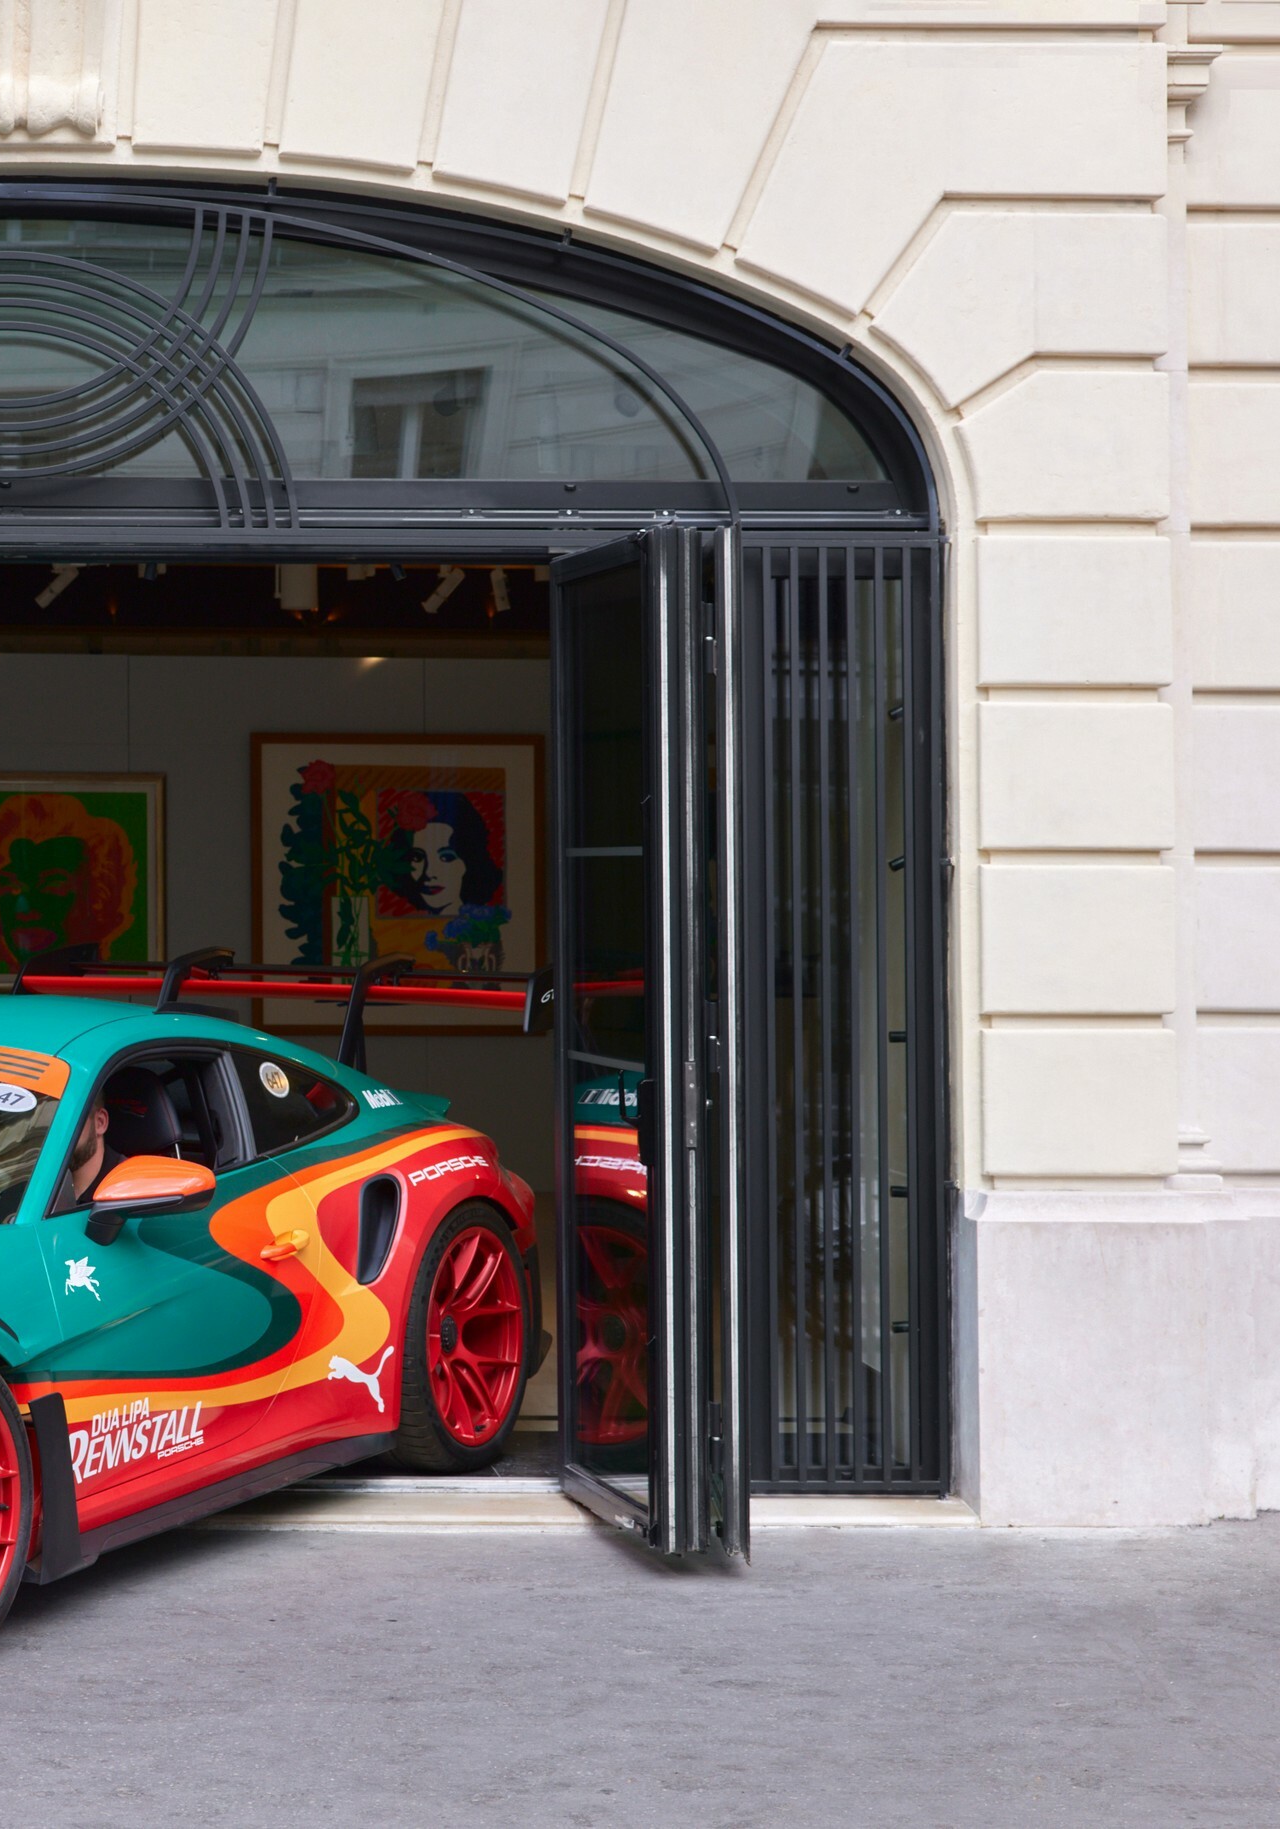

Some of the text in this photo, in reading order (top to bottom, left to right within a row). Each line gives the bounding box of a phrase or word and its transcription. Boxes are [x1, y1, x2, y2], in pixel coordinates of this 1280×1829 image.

[265, 1071, 284, 1089] 647
[361, 1089, 395, 1109] Mobil
[408, 1155, 489, 1187] PORSCHE
[91, 1397, 150, 1437] DUA LIPA
[69, 1401, 204, 1484] RENNSTALL
[157, 1436, 204, 1460] PORSCHE
